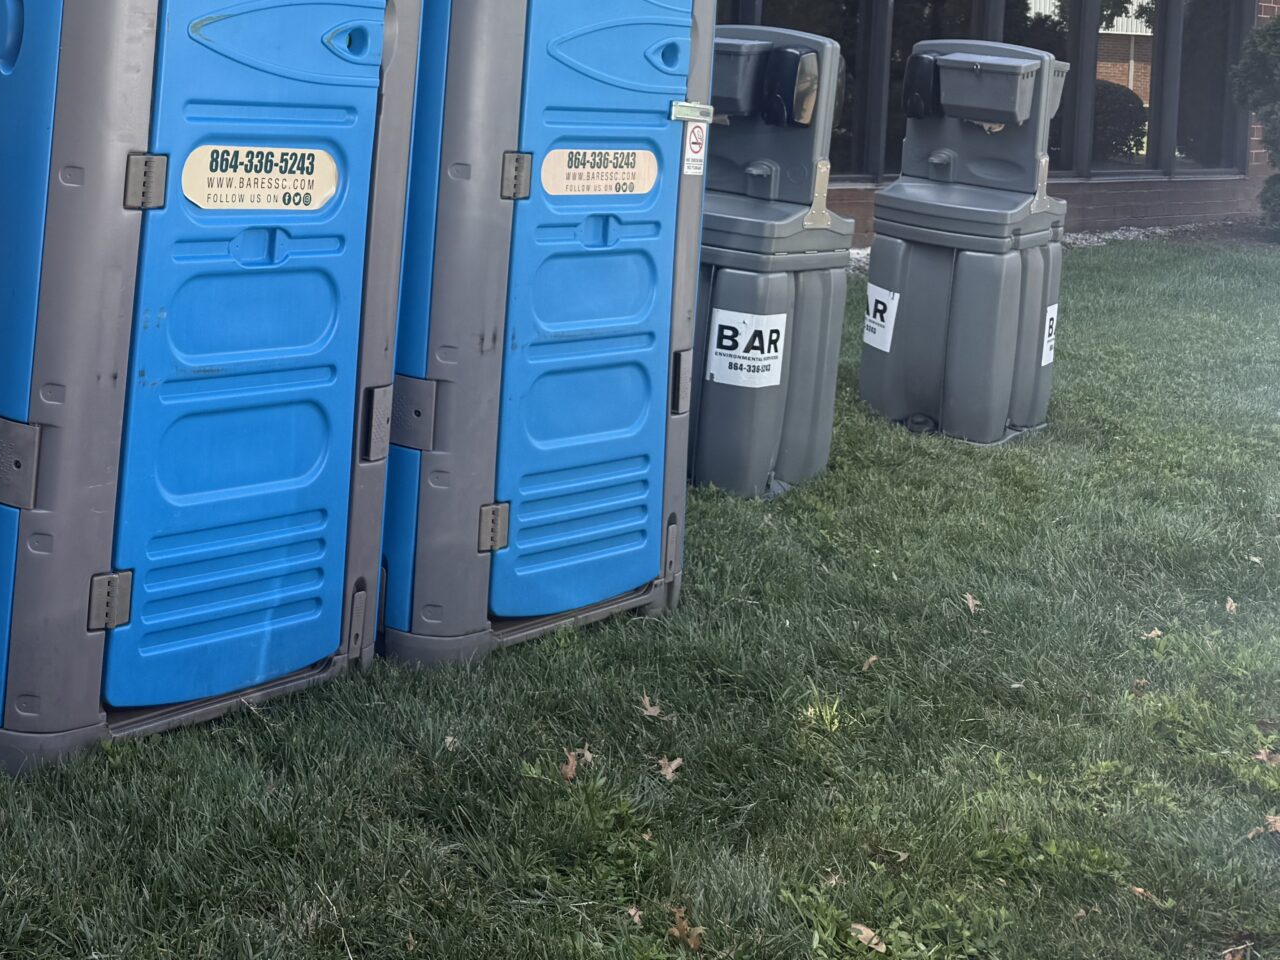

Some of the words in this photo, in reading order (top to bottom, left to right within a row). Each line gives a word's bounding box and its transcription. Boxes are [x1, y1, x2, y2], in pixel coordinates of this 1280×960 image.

[209, 149, 316, 176] 864-336-5243
[567, 151, 637, 169] 864-336-5243
[565, 171, 637, 181] WWW.BARESSC.COM
[207, 177, 315, 190] WWW.BARESSC.COM
[565, 184, 591, 192] FOLLOW
[593, 184, 603, 192] US
[605, 184, 613, 192] ON
[207, 193, 245, 203] FOLLOW
[250, 193, 262, 203] US
[266, 193, 279, 203] ON
[716, 323, 781, 355] BAR
